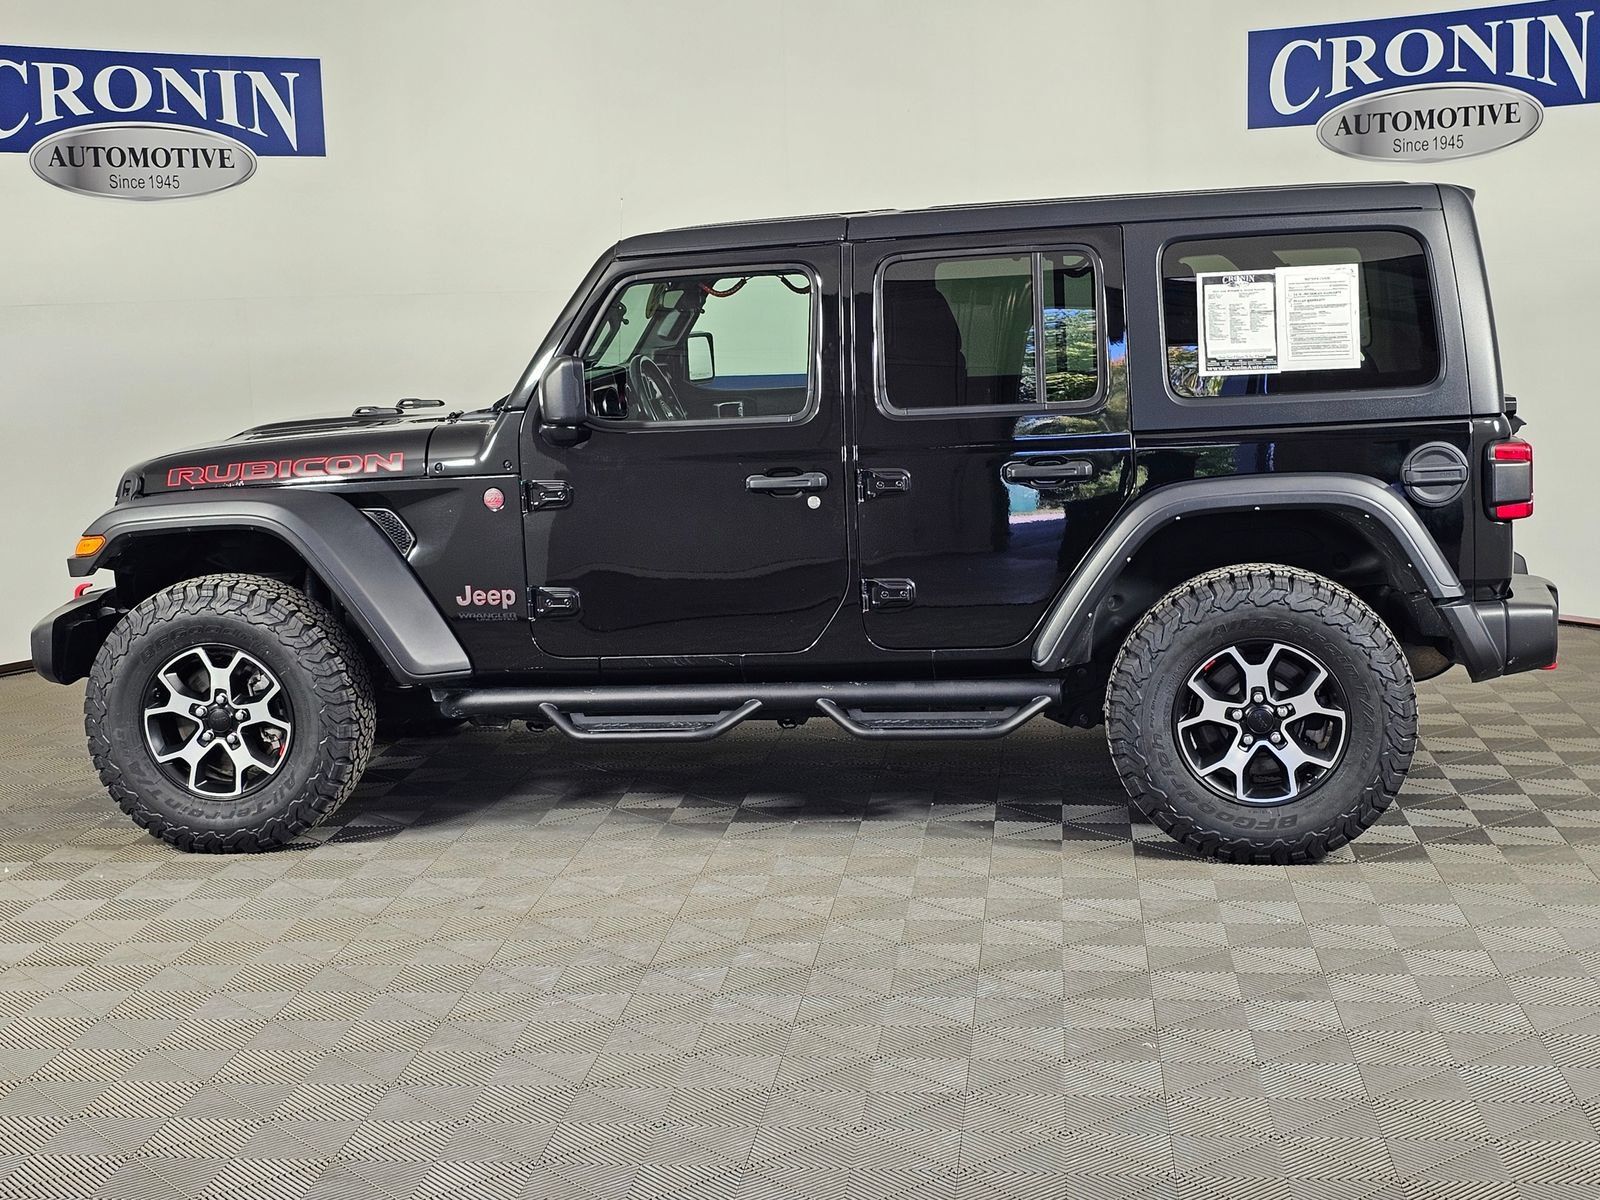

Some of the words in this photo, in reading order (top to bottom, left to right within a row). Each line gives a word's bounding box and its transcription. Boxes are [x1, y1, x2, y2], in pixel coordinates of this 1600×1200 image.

[1269, 10, 1595, 115] CRONIN
[1334, 102, 1521, 136] AUTOMOTIVE
[1392, 137, 1430, 153] Since
[1432, 134, 1465, 151] 1945
[48, 145, 236, 169] AUTOMOTIVE
[109, 174, 146, 190] Since
[149, 174, 181, 190] 1945
[166, 452, 404, 487] RUBICON
[455, 585, 516, 610] Jeep
[457, 611, 518, 620] WRANGLER
[1152, 733, 1298, 831] BFGoodrich
